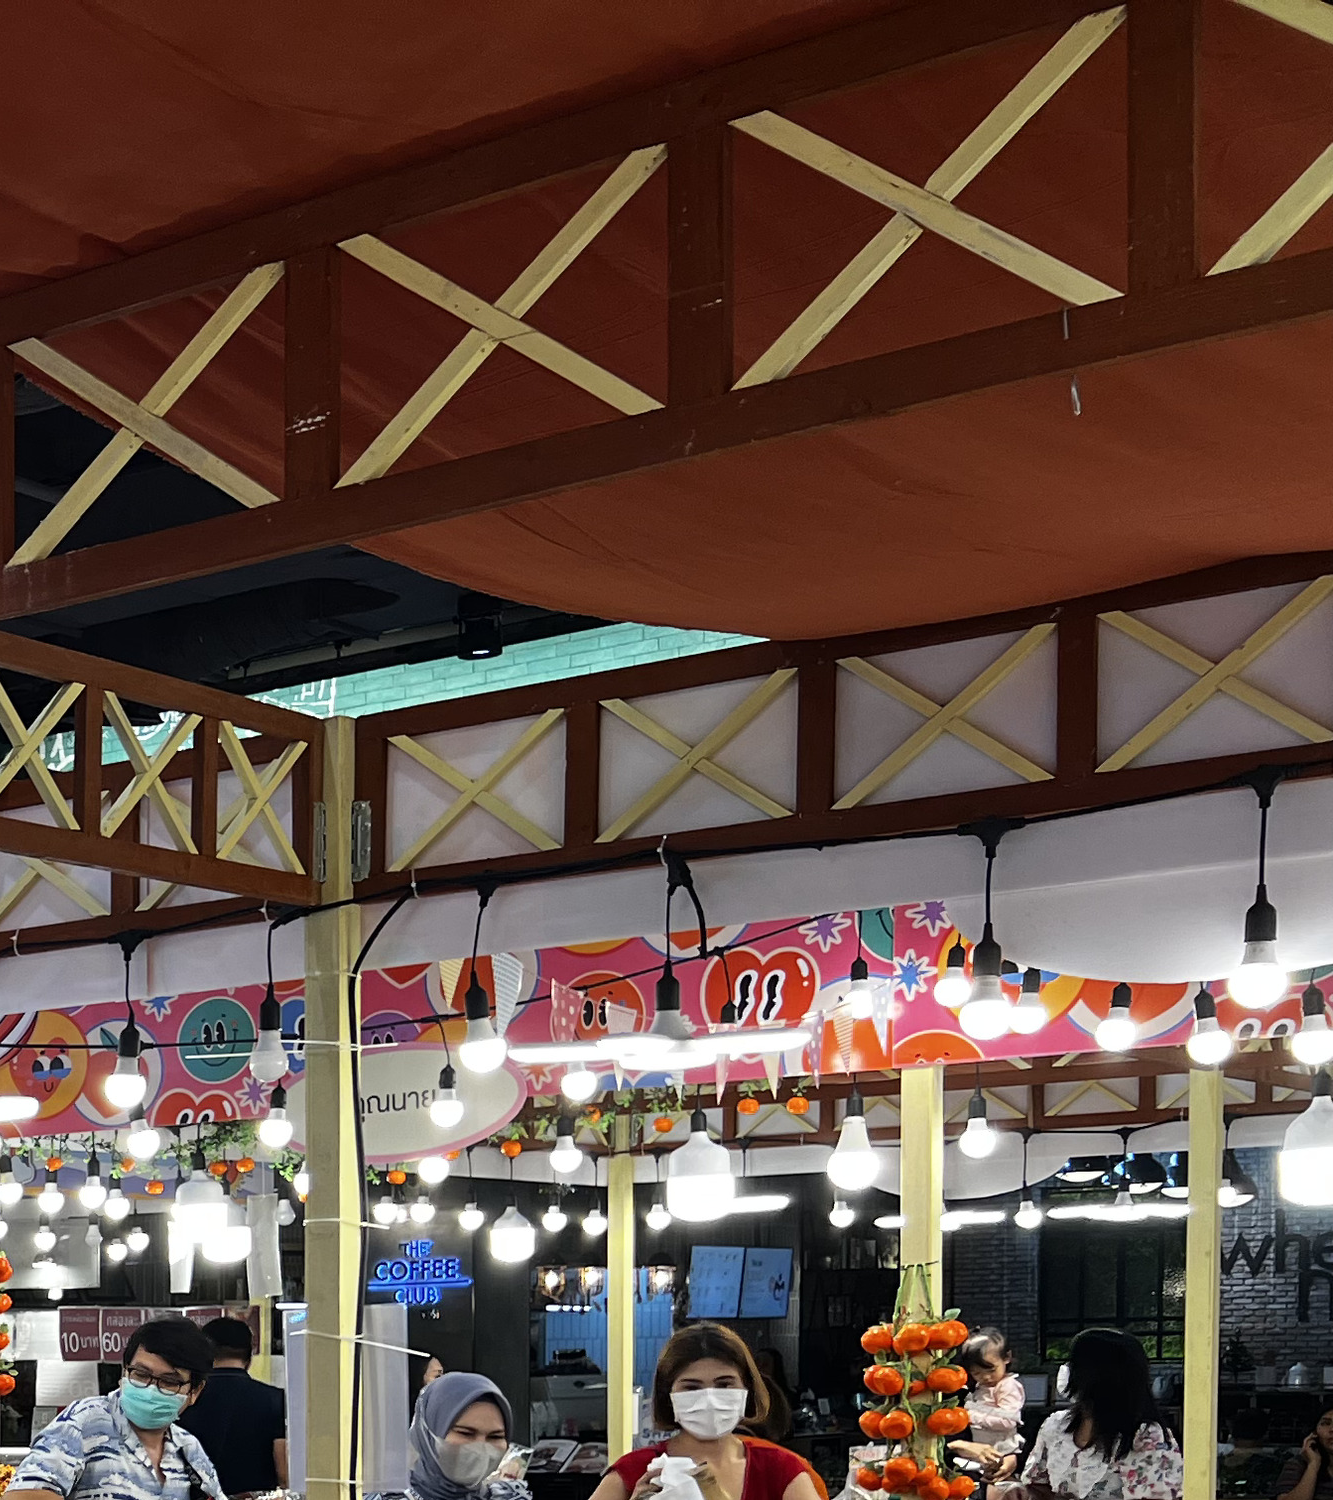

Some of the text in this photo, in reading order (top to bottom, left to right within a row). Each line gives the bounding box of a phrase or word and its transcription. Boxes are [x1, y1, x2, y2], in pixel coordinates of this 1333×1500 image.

[399, 1239, 435, 1258] THE
[374, 1257, 461, 1281] COFFEE
[394, 1286, 442, 1305] CLUB
[61, 1332, 79, 1353] 10
[102, 1332, 121, 1352] 60
